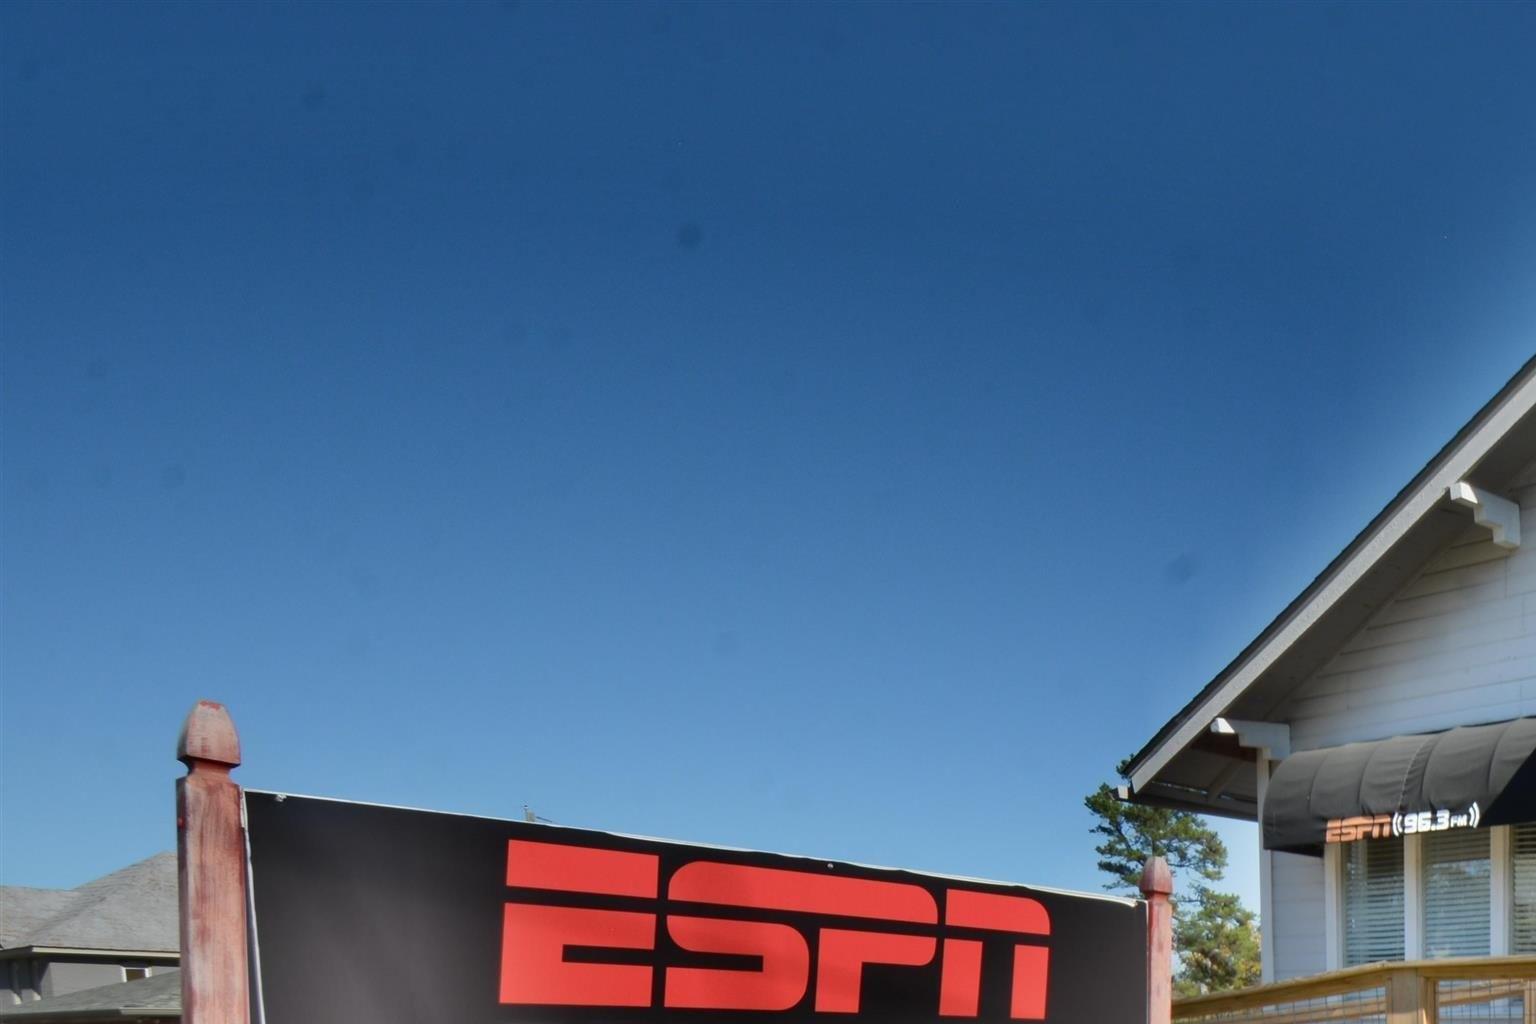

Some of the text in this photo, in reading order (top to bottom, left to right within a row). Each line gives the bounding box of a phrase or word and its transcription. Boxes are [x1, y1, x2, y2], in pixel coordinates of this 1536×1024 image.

[1326, 809, 1468, 843] ESPN 96.3 FM
[499, 839, 1051, 1020] ESPN
